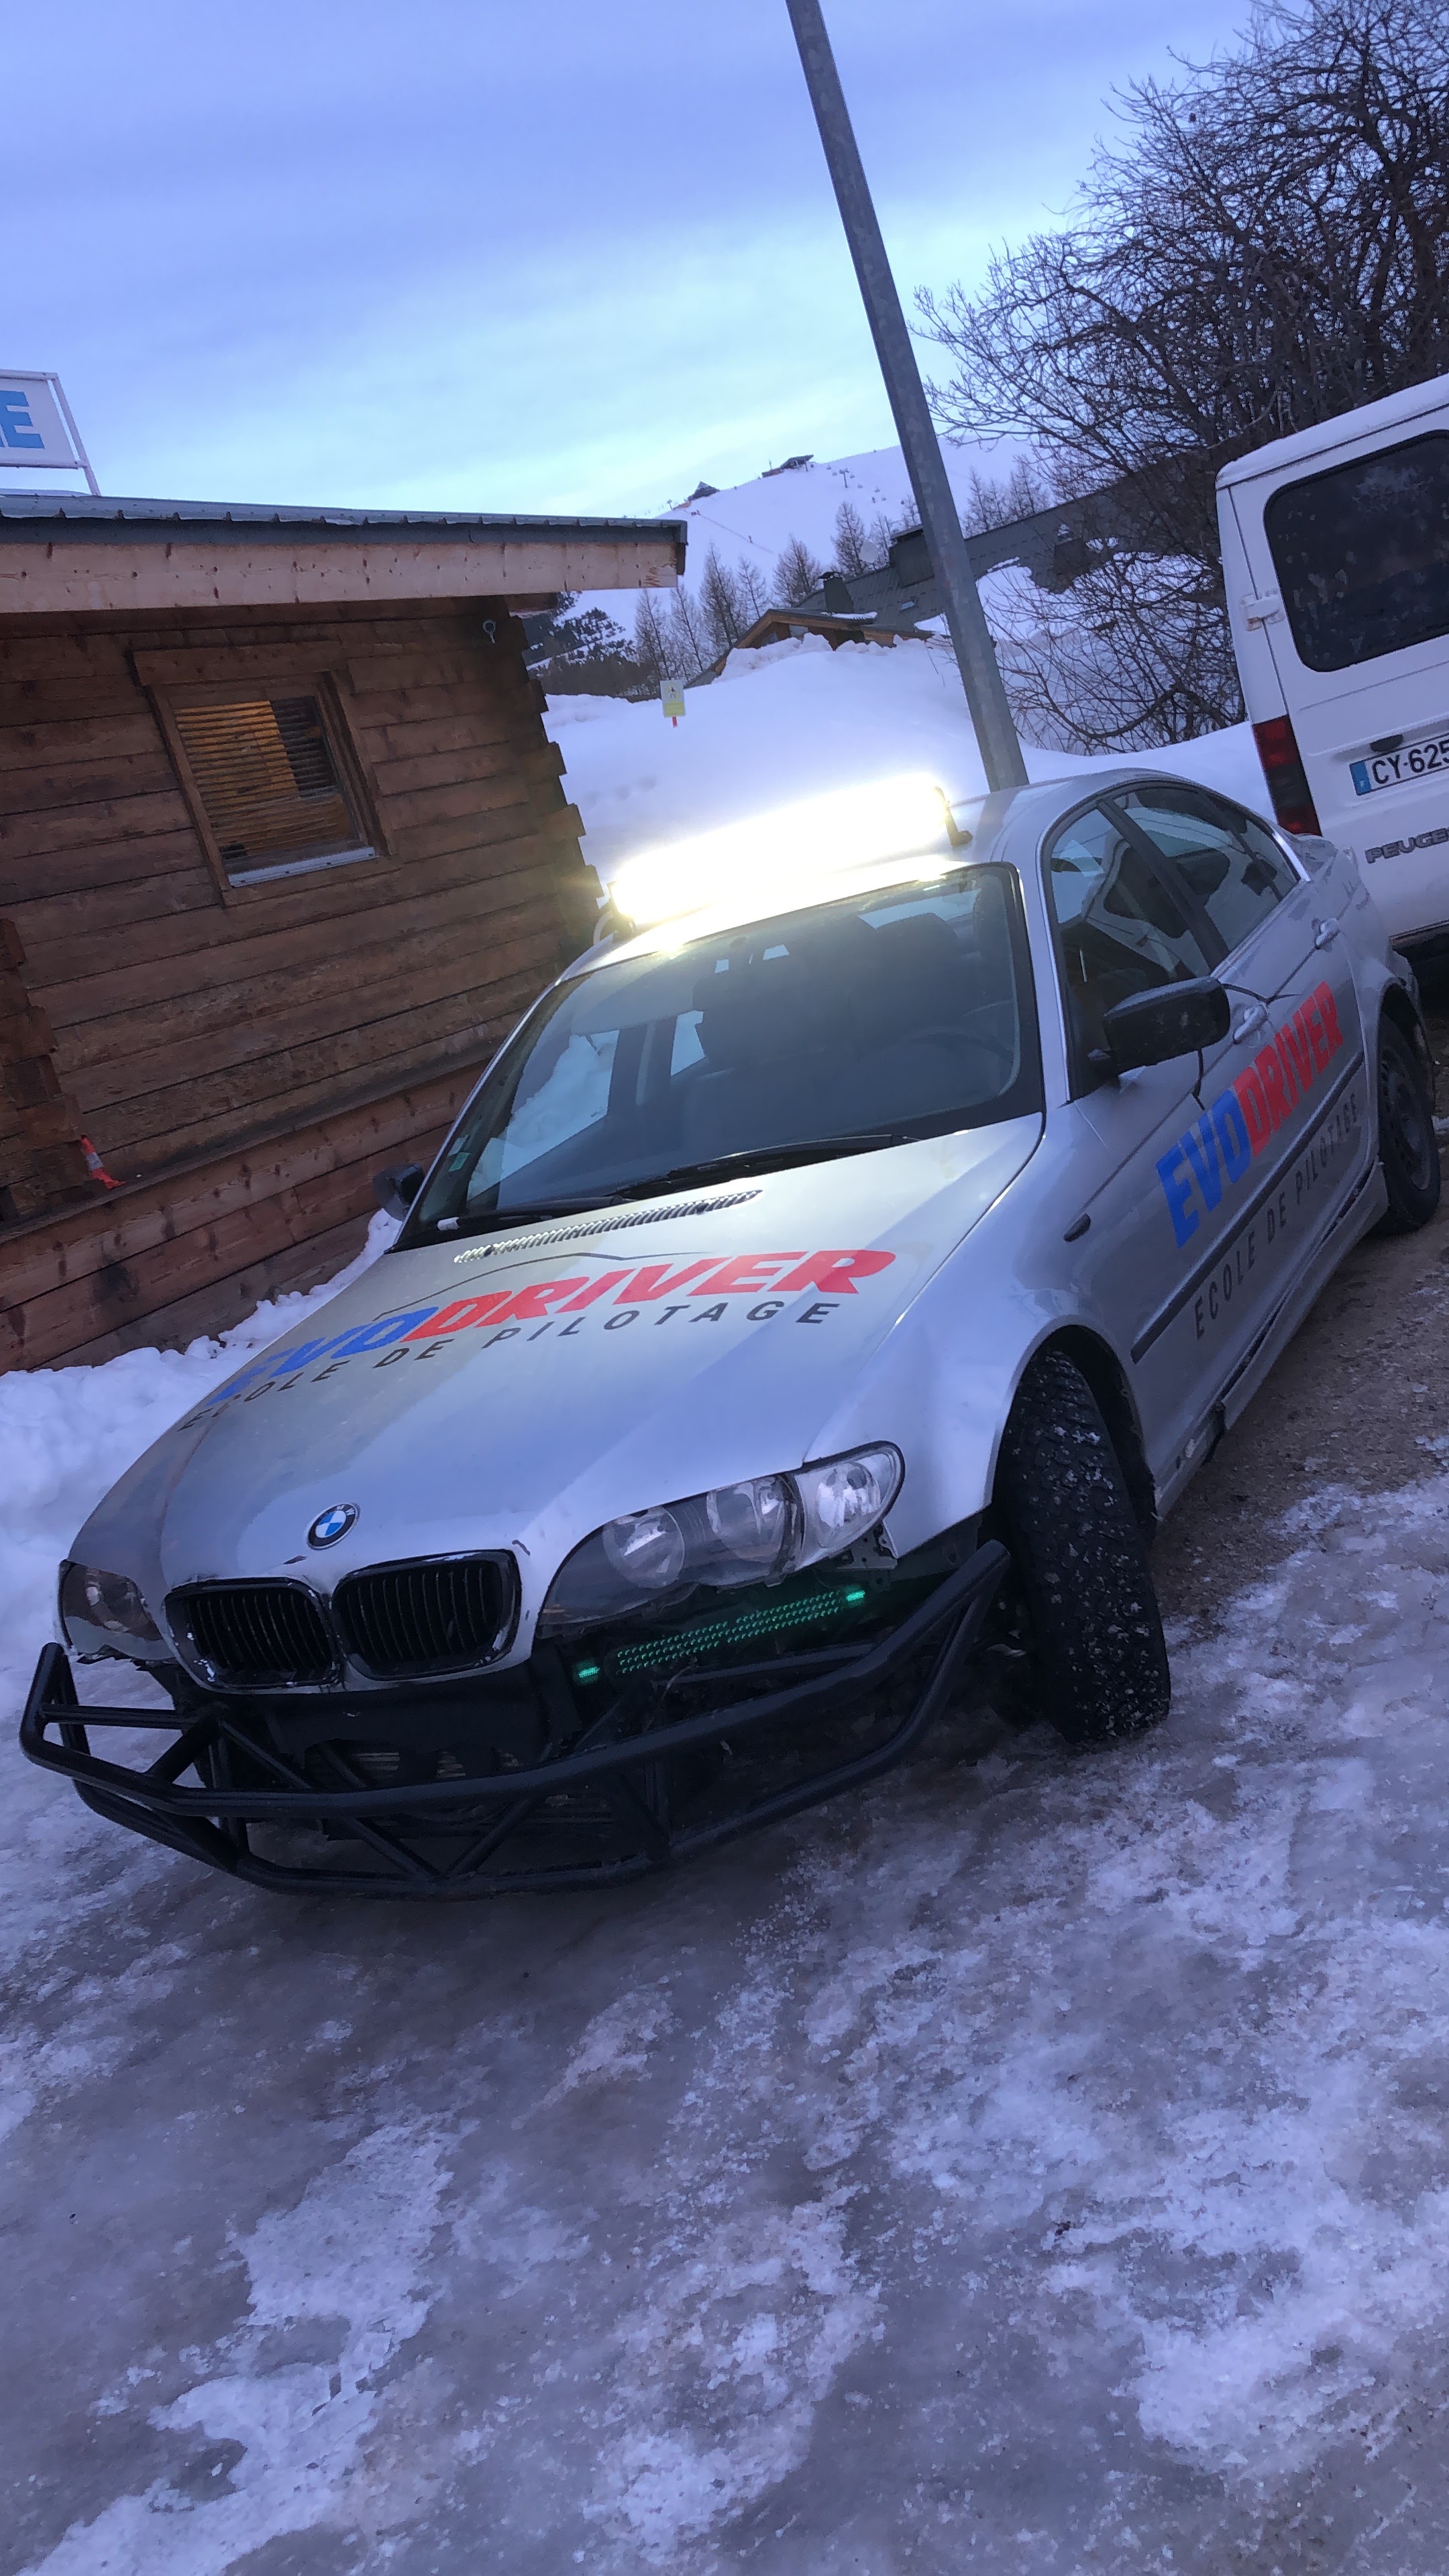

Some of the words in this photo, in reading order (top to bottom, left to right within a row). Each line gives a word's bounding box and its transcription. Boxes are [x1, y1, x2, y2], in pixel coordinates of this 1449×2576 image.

[0, 390, 45, 449] E
[1364, 827, 1449, 864] PEUGE
[1155, 981, 1344, 1249] EVODRIVER
[1193, 1230, 1256, 1341] ECOLE
[1266, 1191, 1287, 1245] DE
[205, 1249, 897, 1407] EVODRIVER
[373, 1338, 455, 1368] DE
[481, 1300, 841, 1350] PILOTAGE
